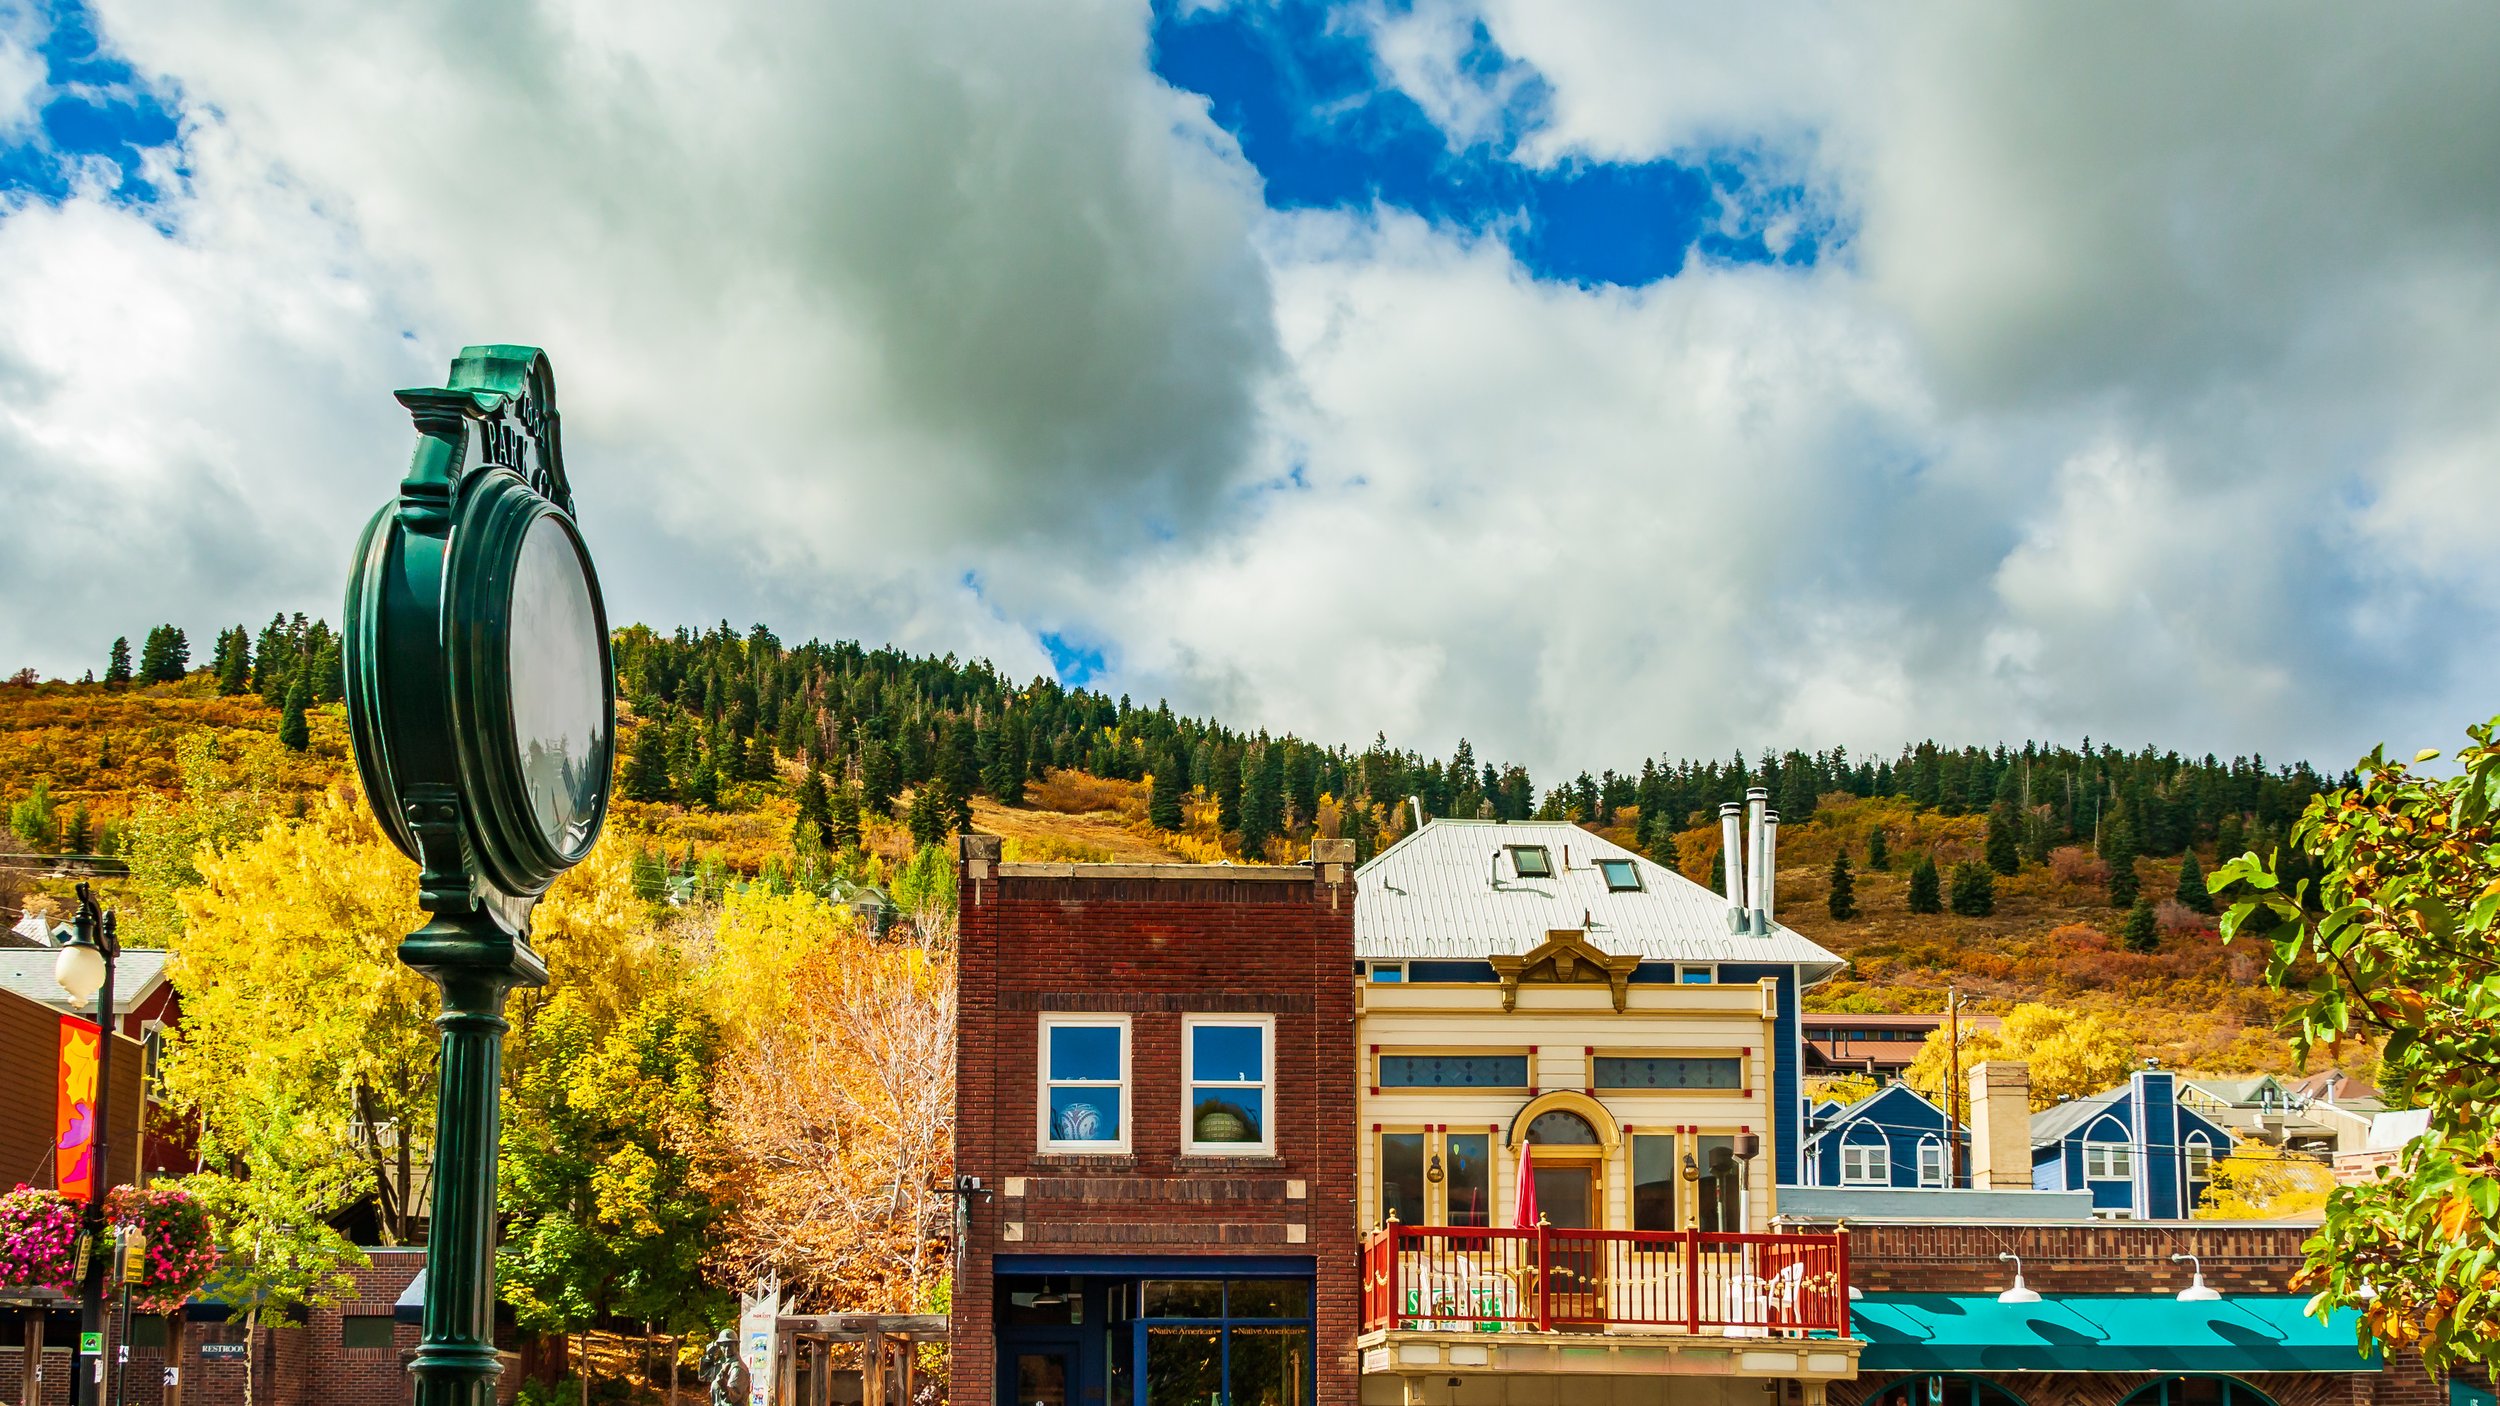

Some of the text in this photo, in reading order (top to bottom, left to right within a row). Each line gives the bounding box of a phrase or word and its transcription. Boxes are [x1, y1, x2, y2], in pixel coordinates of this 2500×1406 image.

[487, 420, 529, 478] PARK
[1153, 1327, 1217, 1335] Native American
[1238, 1327, 1301, 1335] Native American
